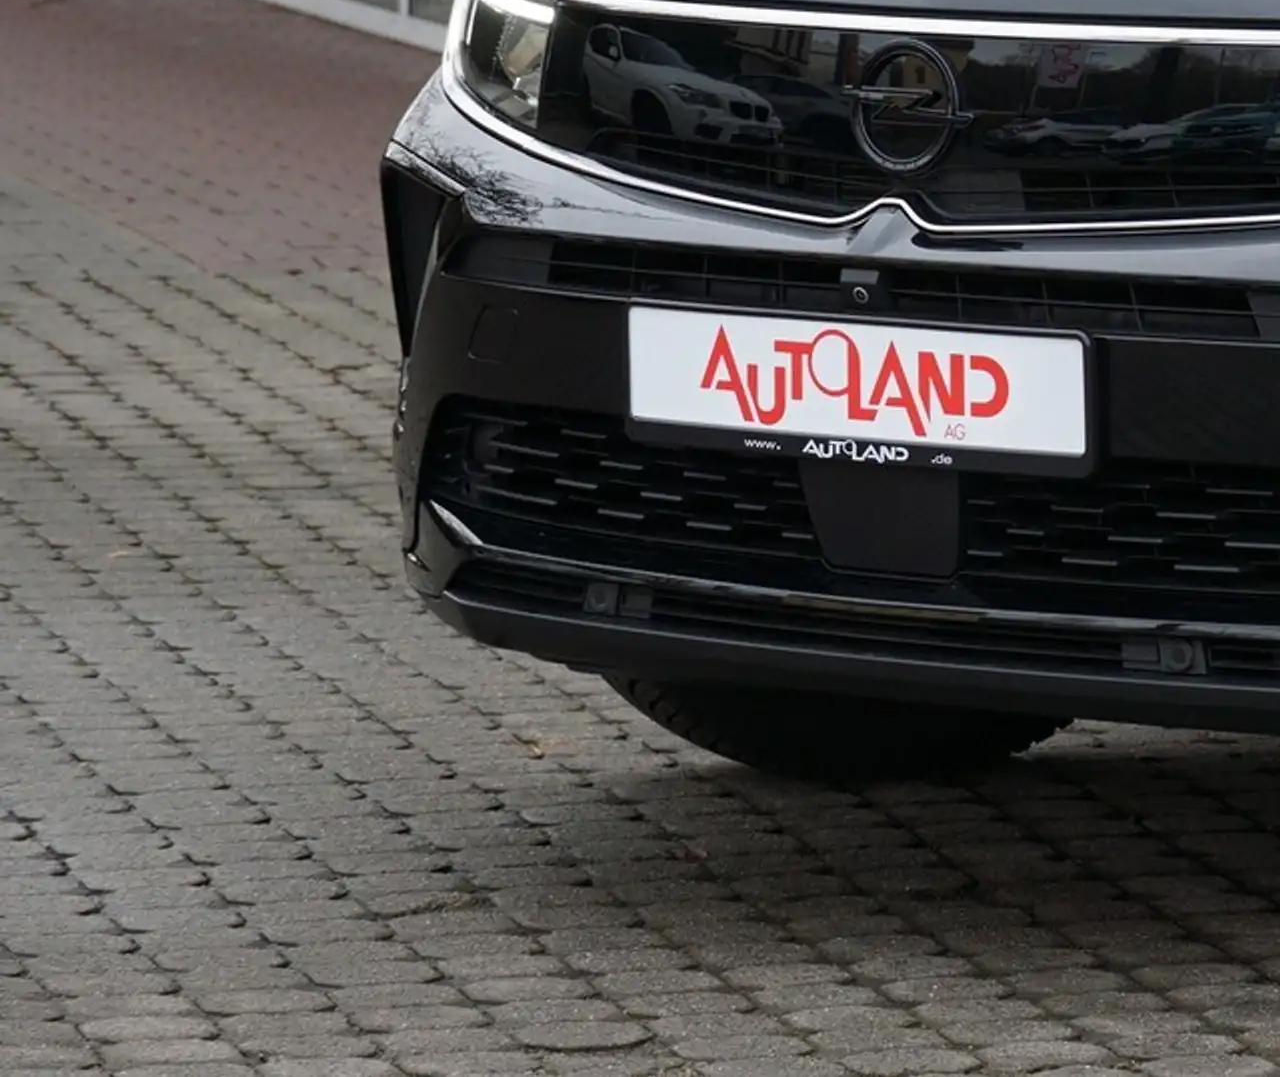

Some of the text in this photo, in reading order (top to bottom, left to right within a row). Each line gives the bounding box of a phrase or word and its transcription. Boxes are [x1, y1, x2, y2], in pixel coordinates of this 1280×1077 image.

[700, 324, 1009, 437] AUTOLAND
[944, 424, 966, 441] AG
[744, 438, 953, 465] www. AUTOLAND .de
